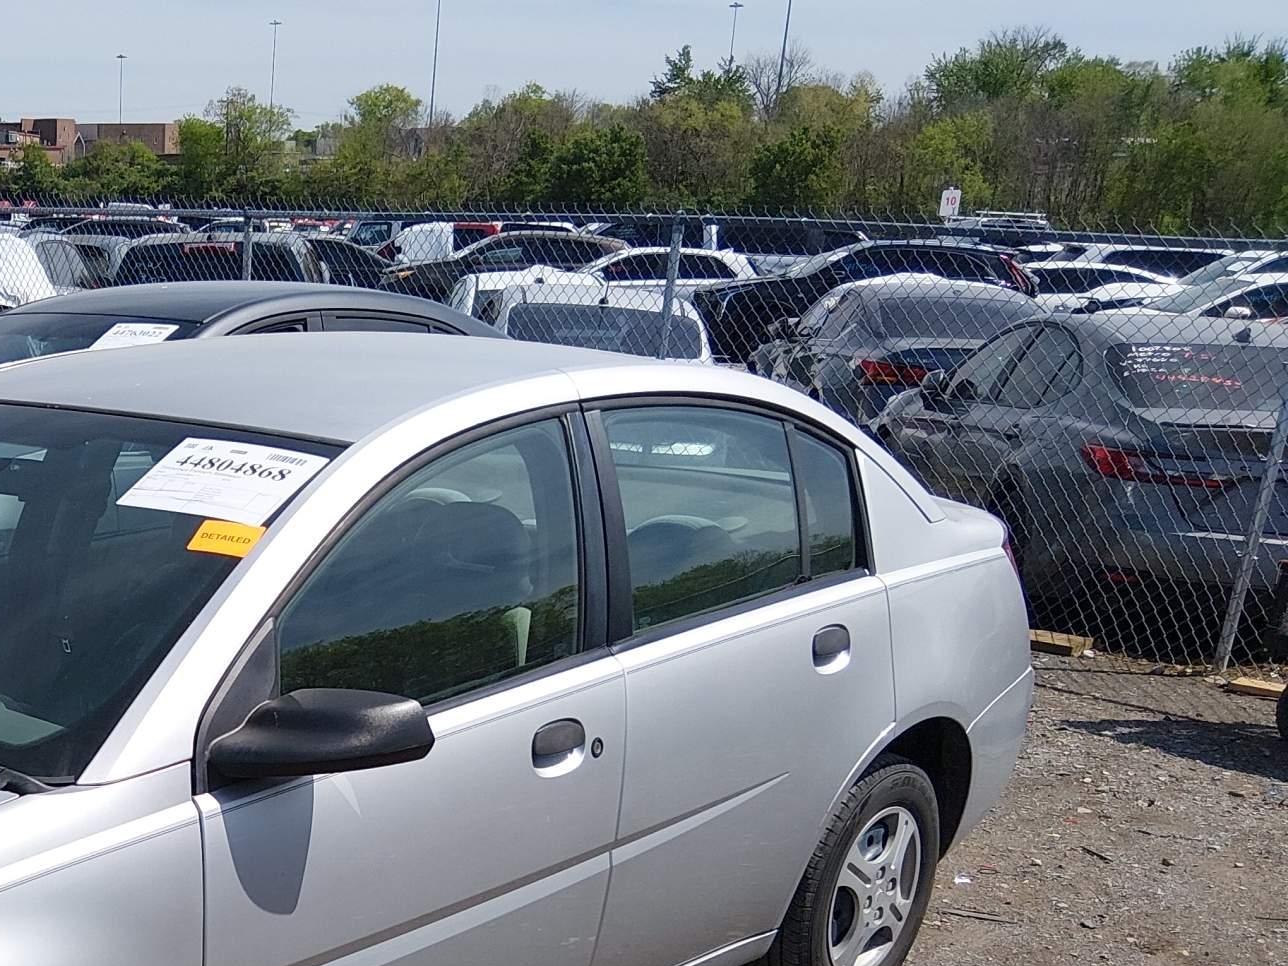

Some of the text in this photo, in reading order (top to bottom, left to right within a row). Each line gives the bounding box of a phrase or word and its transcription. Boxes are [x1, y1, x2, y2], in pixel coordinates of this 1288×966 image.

[945, 196, 957, 207] 10
[176, 454, 293, 482] 44804868
[199, 531, 251, 546] DETAILED
